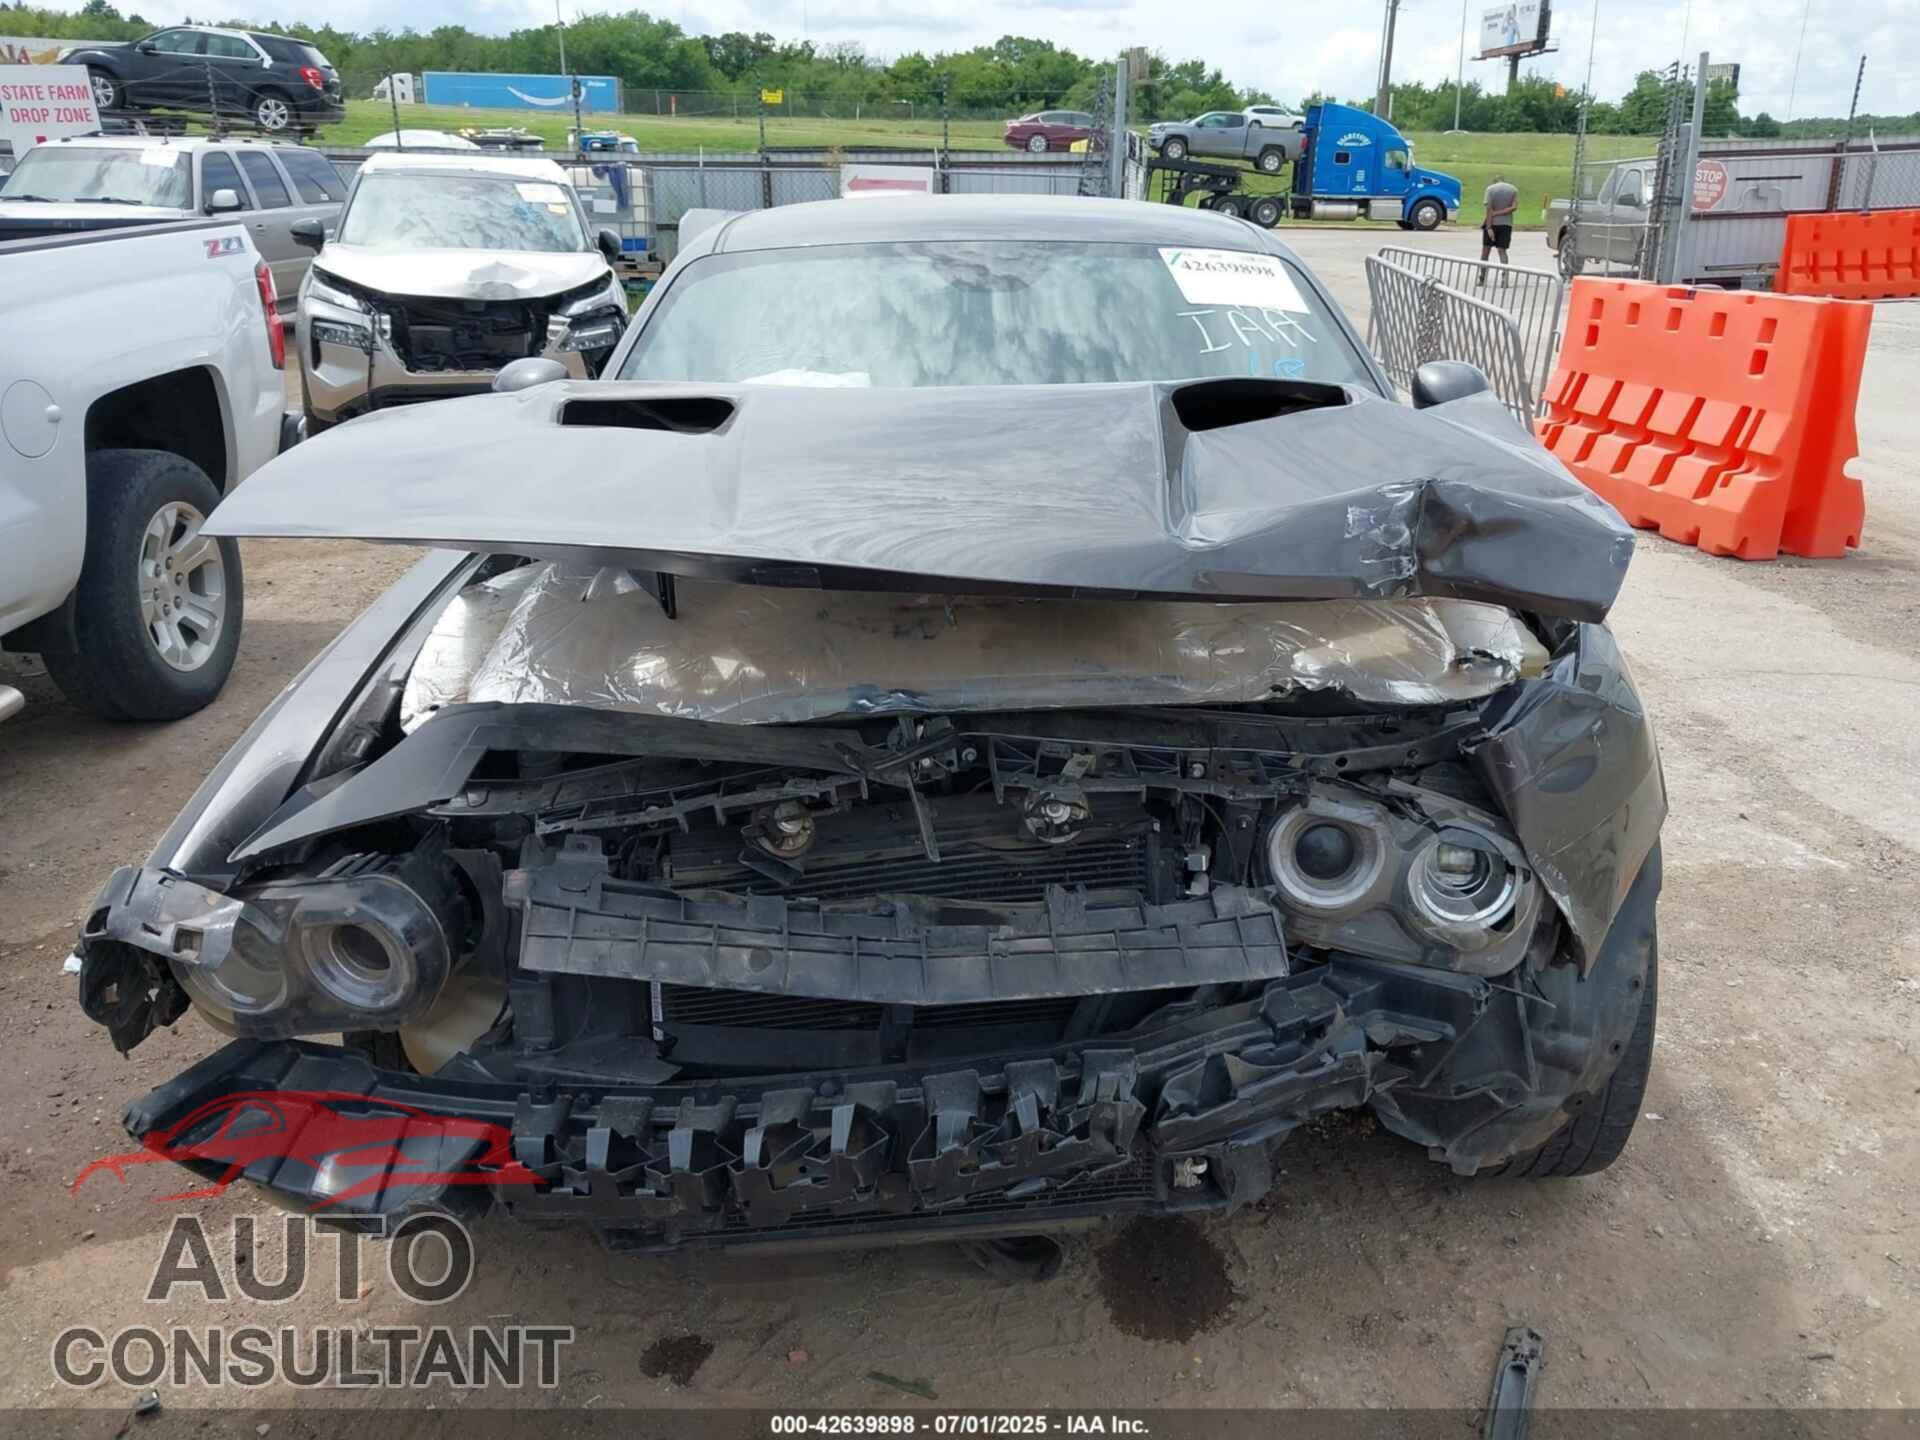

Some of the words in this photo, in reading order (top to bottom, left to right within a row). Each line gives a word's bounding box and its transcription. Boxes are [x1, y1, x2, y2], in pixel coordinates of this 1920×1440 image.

[1, 84, 45, 101] STATE
[47, 85, 90, 101] FARM
[10, 107, 50, 123] DROP
[54, 107, 93, 123] ZONE
[1695, 169, 1724, 183] STOP
[1182, 259, 1276, 278] 42639898
[1176, 304, 1318, 354] IAA
